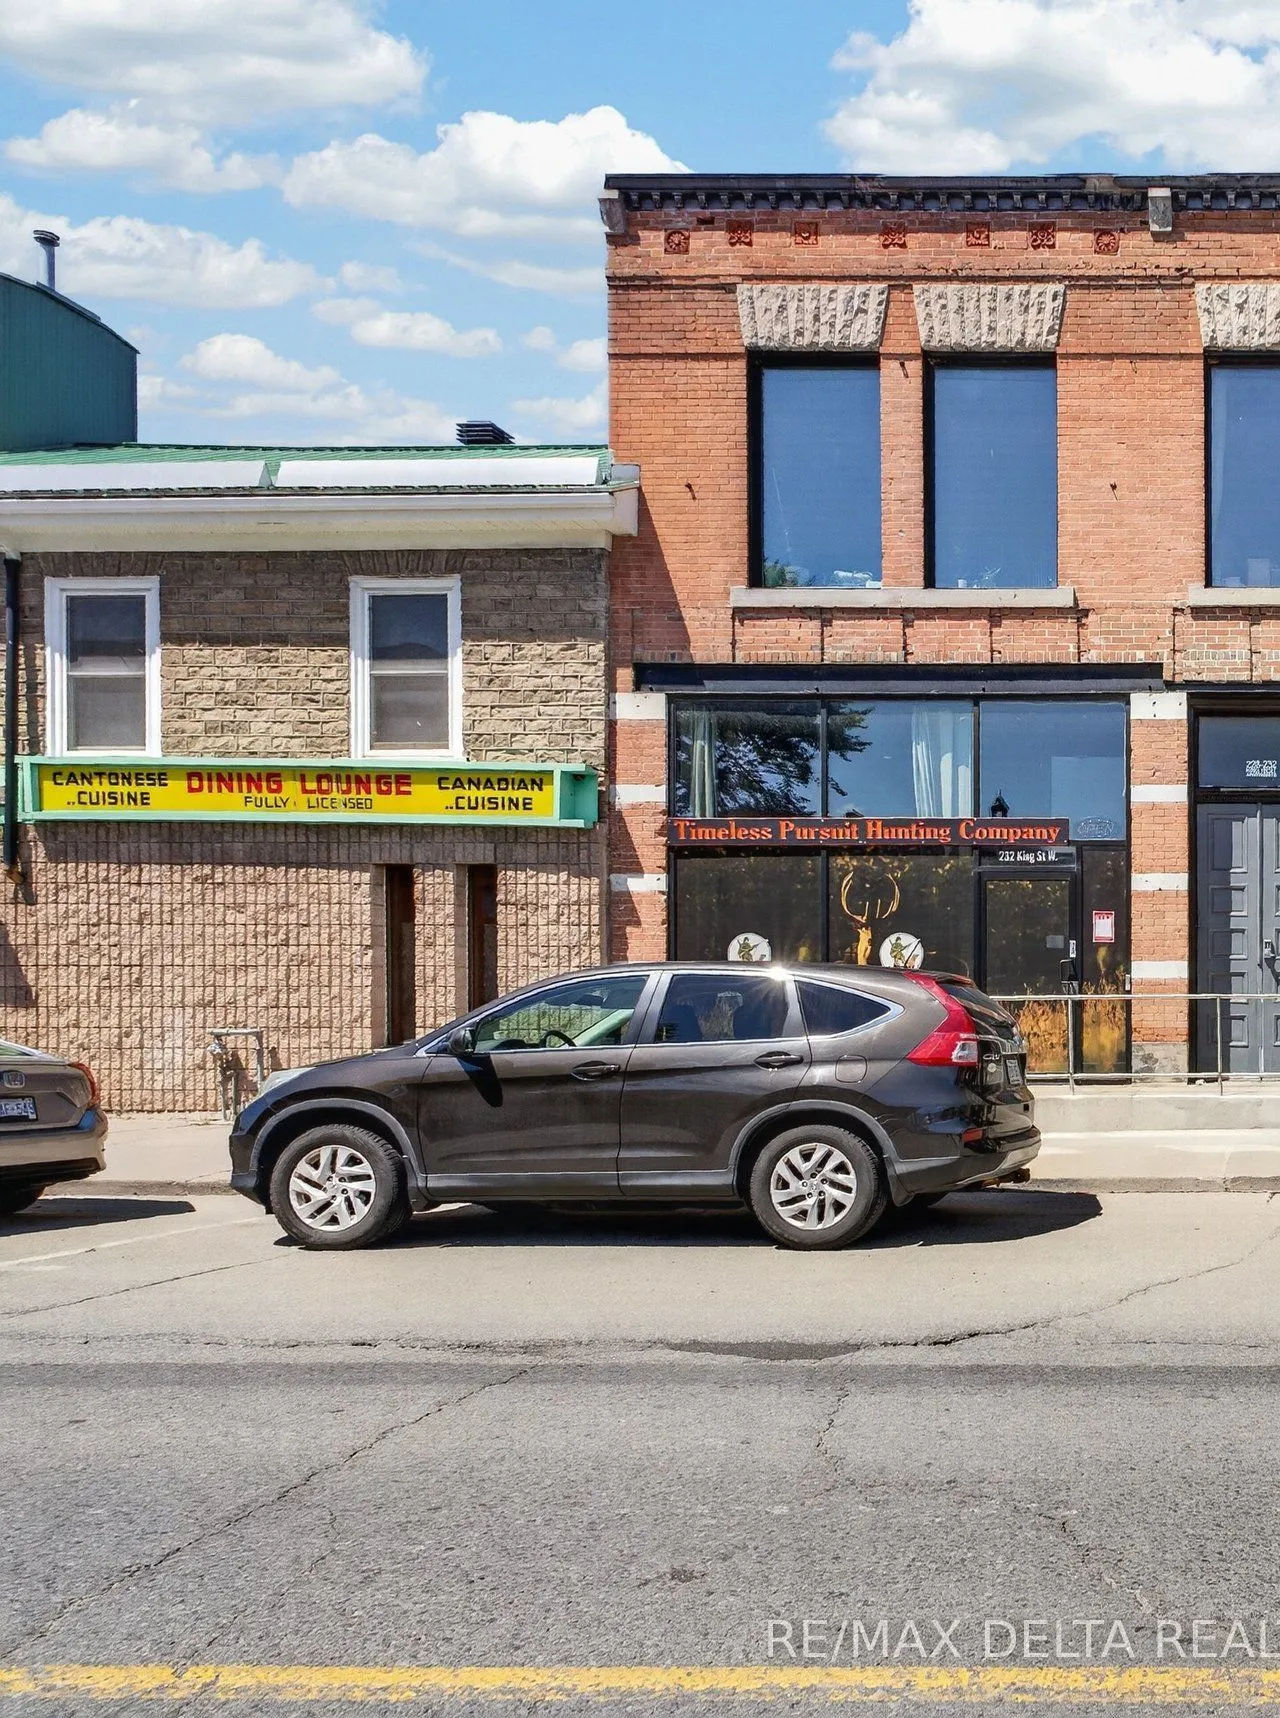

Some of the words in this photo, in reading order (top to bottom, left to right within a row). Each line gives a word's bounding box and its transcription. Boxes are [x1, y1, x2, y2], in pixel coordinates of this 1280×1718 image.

[51, 771, 169, 787] CANTONESE
[185, 771, 283, 794] DINING
[299, 772, 412, 796] LOUNGE
[436, 776, 544, 792] CANADIAN
[243, 795, 290, 809] FULLY
[306, 797, 373, 810] LICENSED
[673, 819, 773, 841] Timeless
[779, 819, 860, 841] Pursuit
[865, 819, 952, 844] Hunting
[959, 819, 1061, 844] Company
[998, 850, 1015, 862] 232
[1016, 850, 1035, 864] King
[1036, 850, 1046, 862] St
